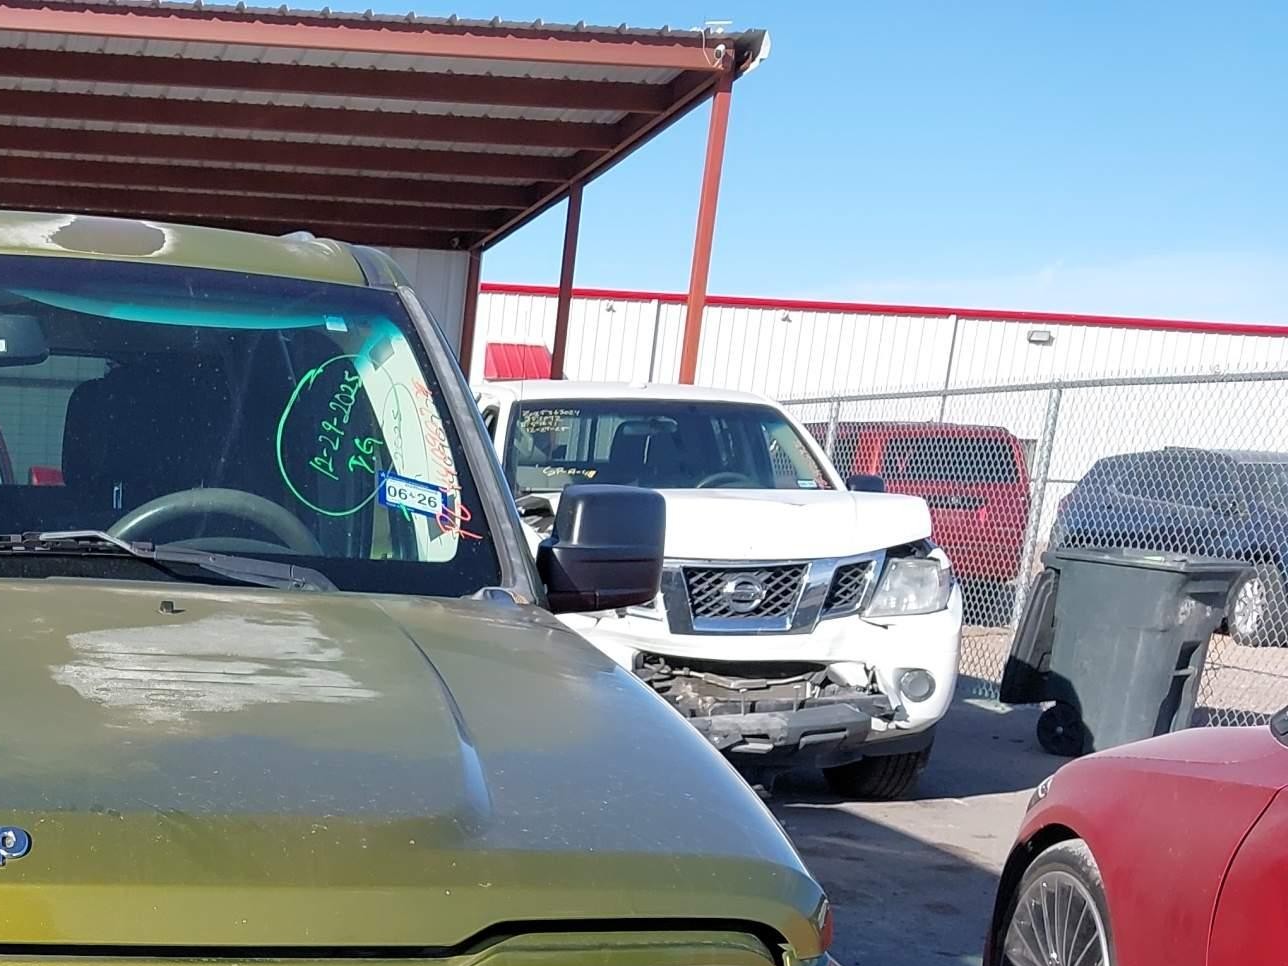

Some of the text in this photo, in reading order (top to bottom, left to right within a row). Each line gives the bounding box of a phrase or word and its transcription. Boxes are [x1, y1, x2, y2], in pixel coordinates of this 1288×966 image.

[308, 369, 363, 480] 12-29-2025
[387, 485, 408, 501] 06
[416, 493, 438, 509] 26
